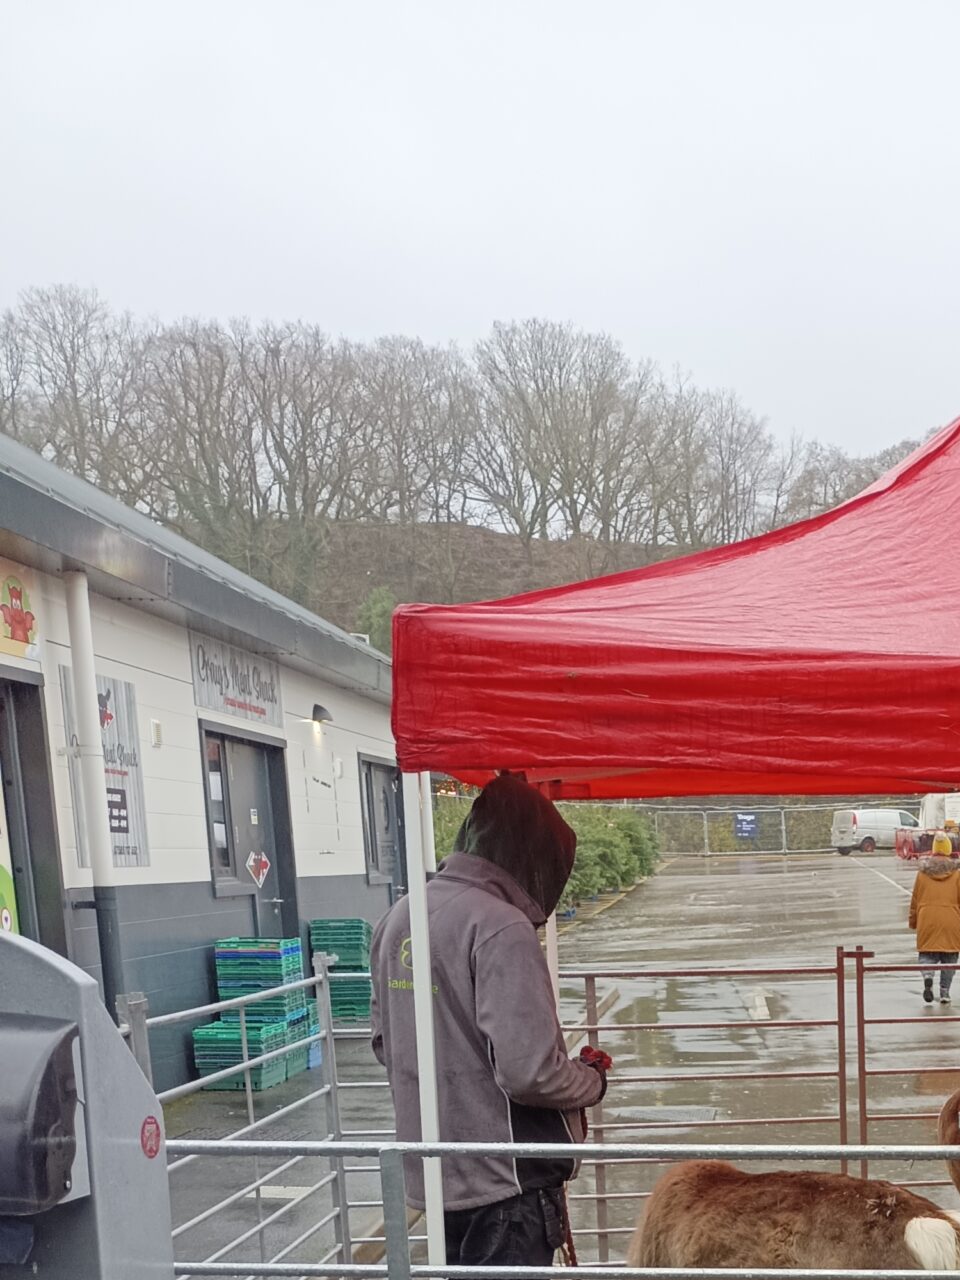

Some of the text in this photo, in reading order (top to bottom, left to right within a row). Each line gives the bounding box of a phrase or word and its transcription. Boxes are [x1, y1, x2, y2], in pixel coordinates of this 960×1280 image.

[197, 644, 277, 704] Craig's Meat Shack
